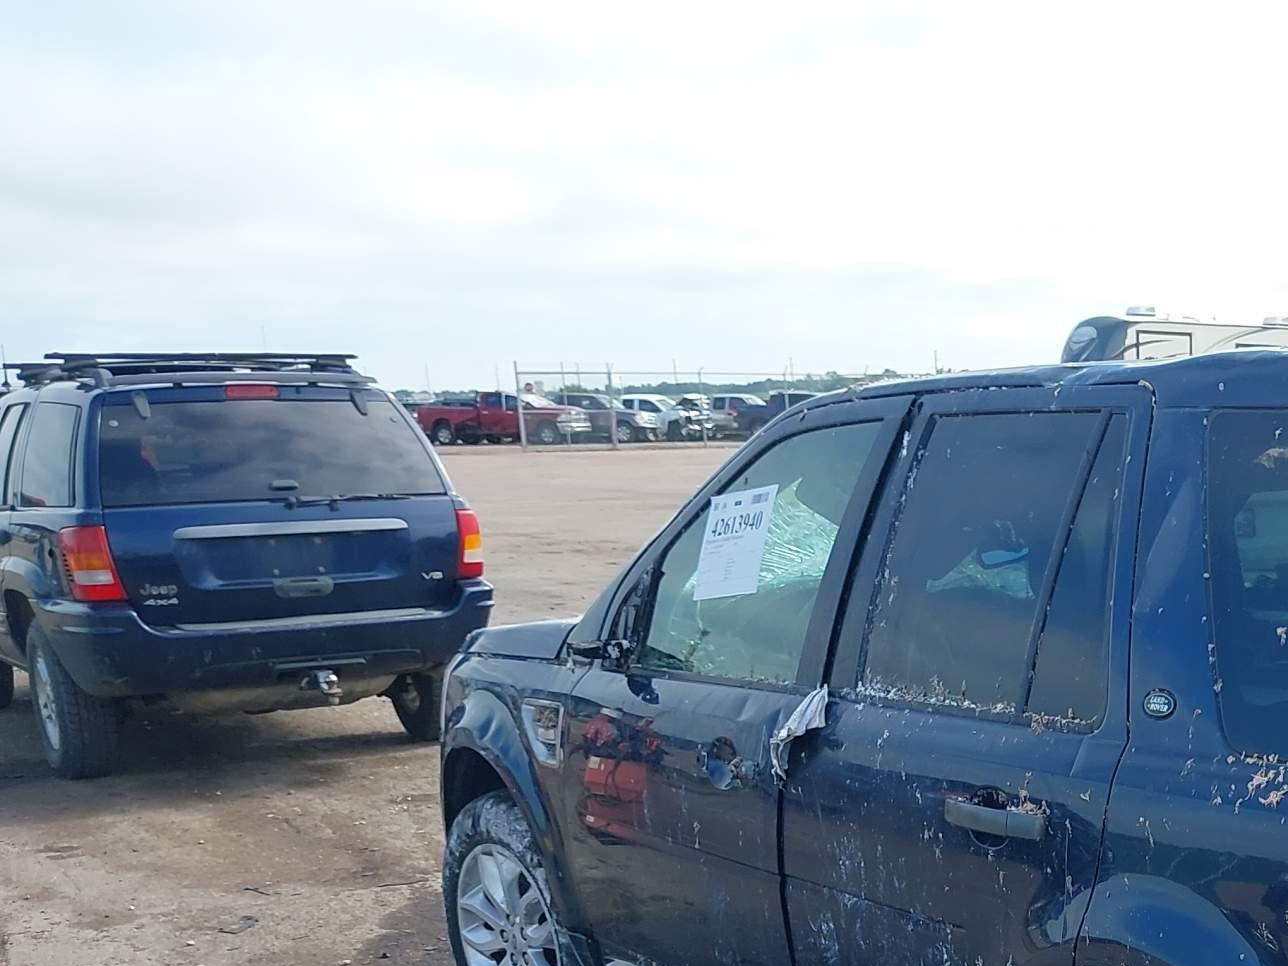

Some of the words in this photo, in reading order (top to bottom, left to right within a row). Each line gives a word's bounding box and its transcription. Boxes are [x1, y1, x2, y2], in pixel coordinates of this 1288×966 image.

[712, 511, 763, 537] 42613940
[139, 583, 178, 596] Jeep
[1150, 704, 1169, 712] ROVER
